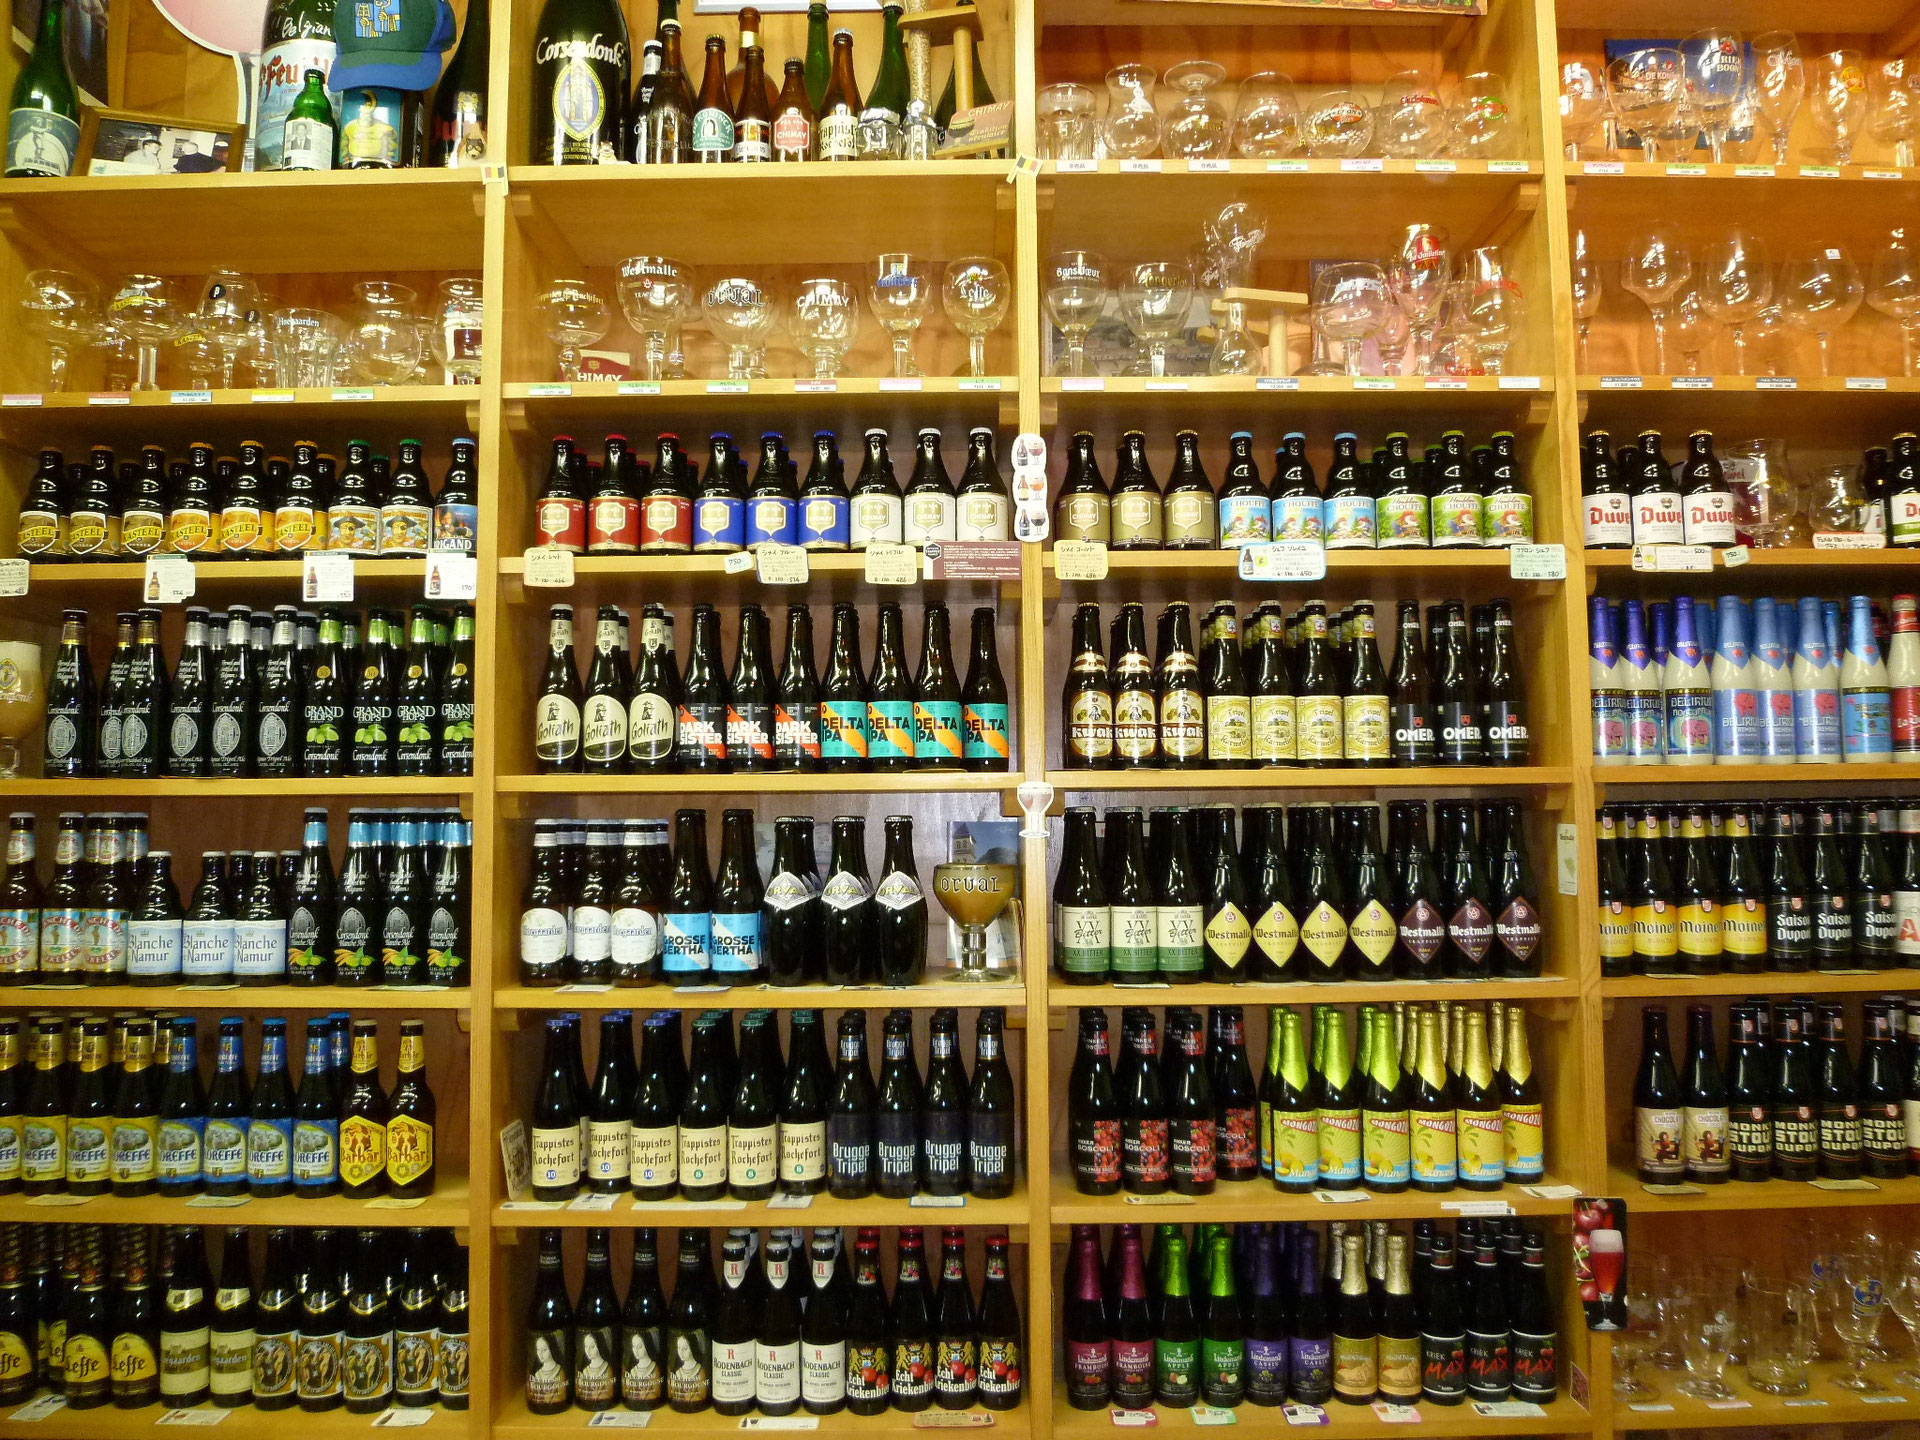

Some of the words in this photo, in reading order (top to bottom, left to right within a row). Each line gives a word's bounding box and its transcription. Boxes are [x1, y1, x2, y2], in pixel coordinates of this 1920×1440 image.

[968, 101, 1011, 118] CHIMAY
[577, 373, 622, 382] HIMAY
[1589, 507, 1630, 525] Duve
[1640, 506, 1682, 525] Duve
[1690, 506, 1734, 524] Duve
[304, 705, 344, 718] GRAND
[353, 706, 392, 718] GRAND
[397, 705, 435, 718] GRAND
[538, 718, 574, 741] Goliath
[632, 717, 668, 741] Goliath
[679, 721, 715, 733] DARK
[775, 721, 811, 733] DARK
[822, 717, 864, 731] DELTA
[868, 717, 910, 730] DELTA
[916, 716, 958, 730] DELTA
[965, 718, 1005, 732] DELTA
[585, 718, 621, 743] Goliath
[822, 730, 843, 743] IPA
[869, 729, 889, 742] IPA
[916, 730, 936, 743] IPA
[966, 731, 984, 743] IPA
[679, 732, 722, 745] SISTER
[727, 732, 768, 745] SISTER
[775, 732, 818, 744] SISTER
[1680, 920, 1719, 933] Moine
[1724, 920, 1765, 933] Moine
[131, 950, 169, 963] Namur
[186, 950, 224, 963] Namur
[237, 951, 274, 963] Namur
[631, 1134, 671, 1150] Trappistes
[680, 1134, 721, 1150] Trappistes
[732, 1134, 772, 1150] Trappistes
[1730, 1131, 1771, 1144] STOU
[1775, 1129, 1816, 1143] STOU
[1821, 1129, 1861, 1142] STOU
[533, 1135, 574, 1151] Trappistes
[925, 1140, 961, 1158] Brugge
[1730, 1143, 1771, 1152] DUPON
[833, 1142, 870, 1160] Brugge
[878, 1142, 915, 1160] Brugge
[970, 1141, 1007, 1160] Brugge
[533, 1152, 574, 1166] Rochefort
[631, 1152, 672, 1166] Rochefort
[681, 1152, 722, 1166] Rochefort
[732, 1152, 772, 1166] Rochefort
[928, 1156, 959, 1174] Tripel
[973, 1157, 1004, 1175] Tripel
[837, 1158, 867, 1176] Tripel
[882, 1157, 912, 1176] Tripel
[1425, 1360, 1465, 1377] MAX
[1470, 1358, 1508, 1376] MAX
[1515, 1358, 1554, 1376] MAX
[847, 1384, 889, 1398] riekenbier
[892, 1380, 933, 1395] Kriekenbie
